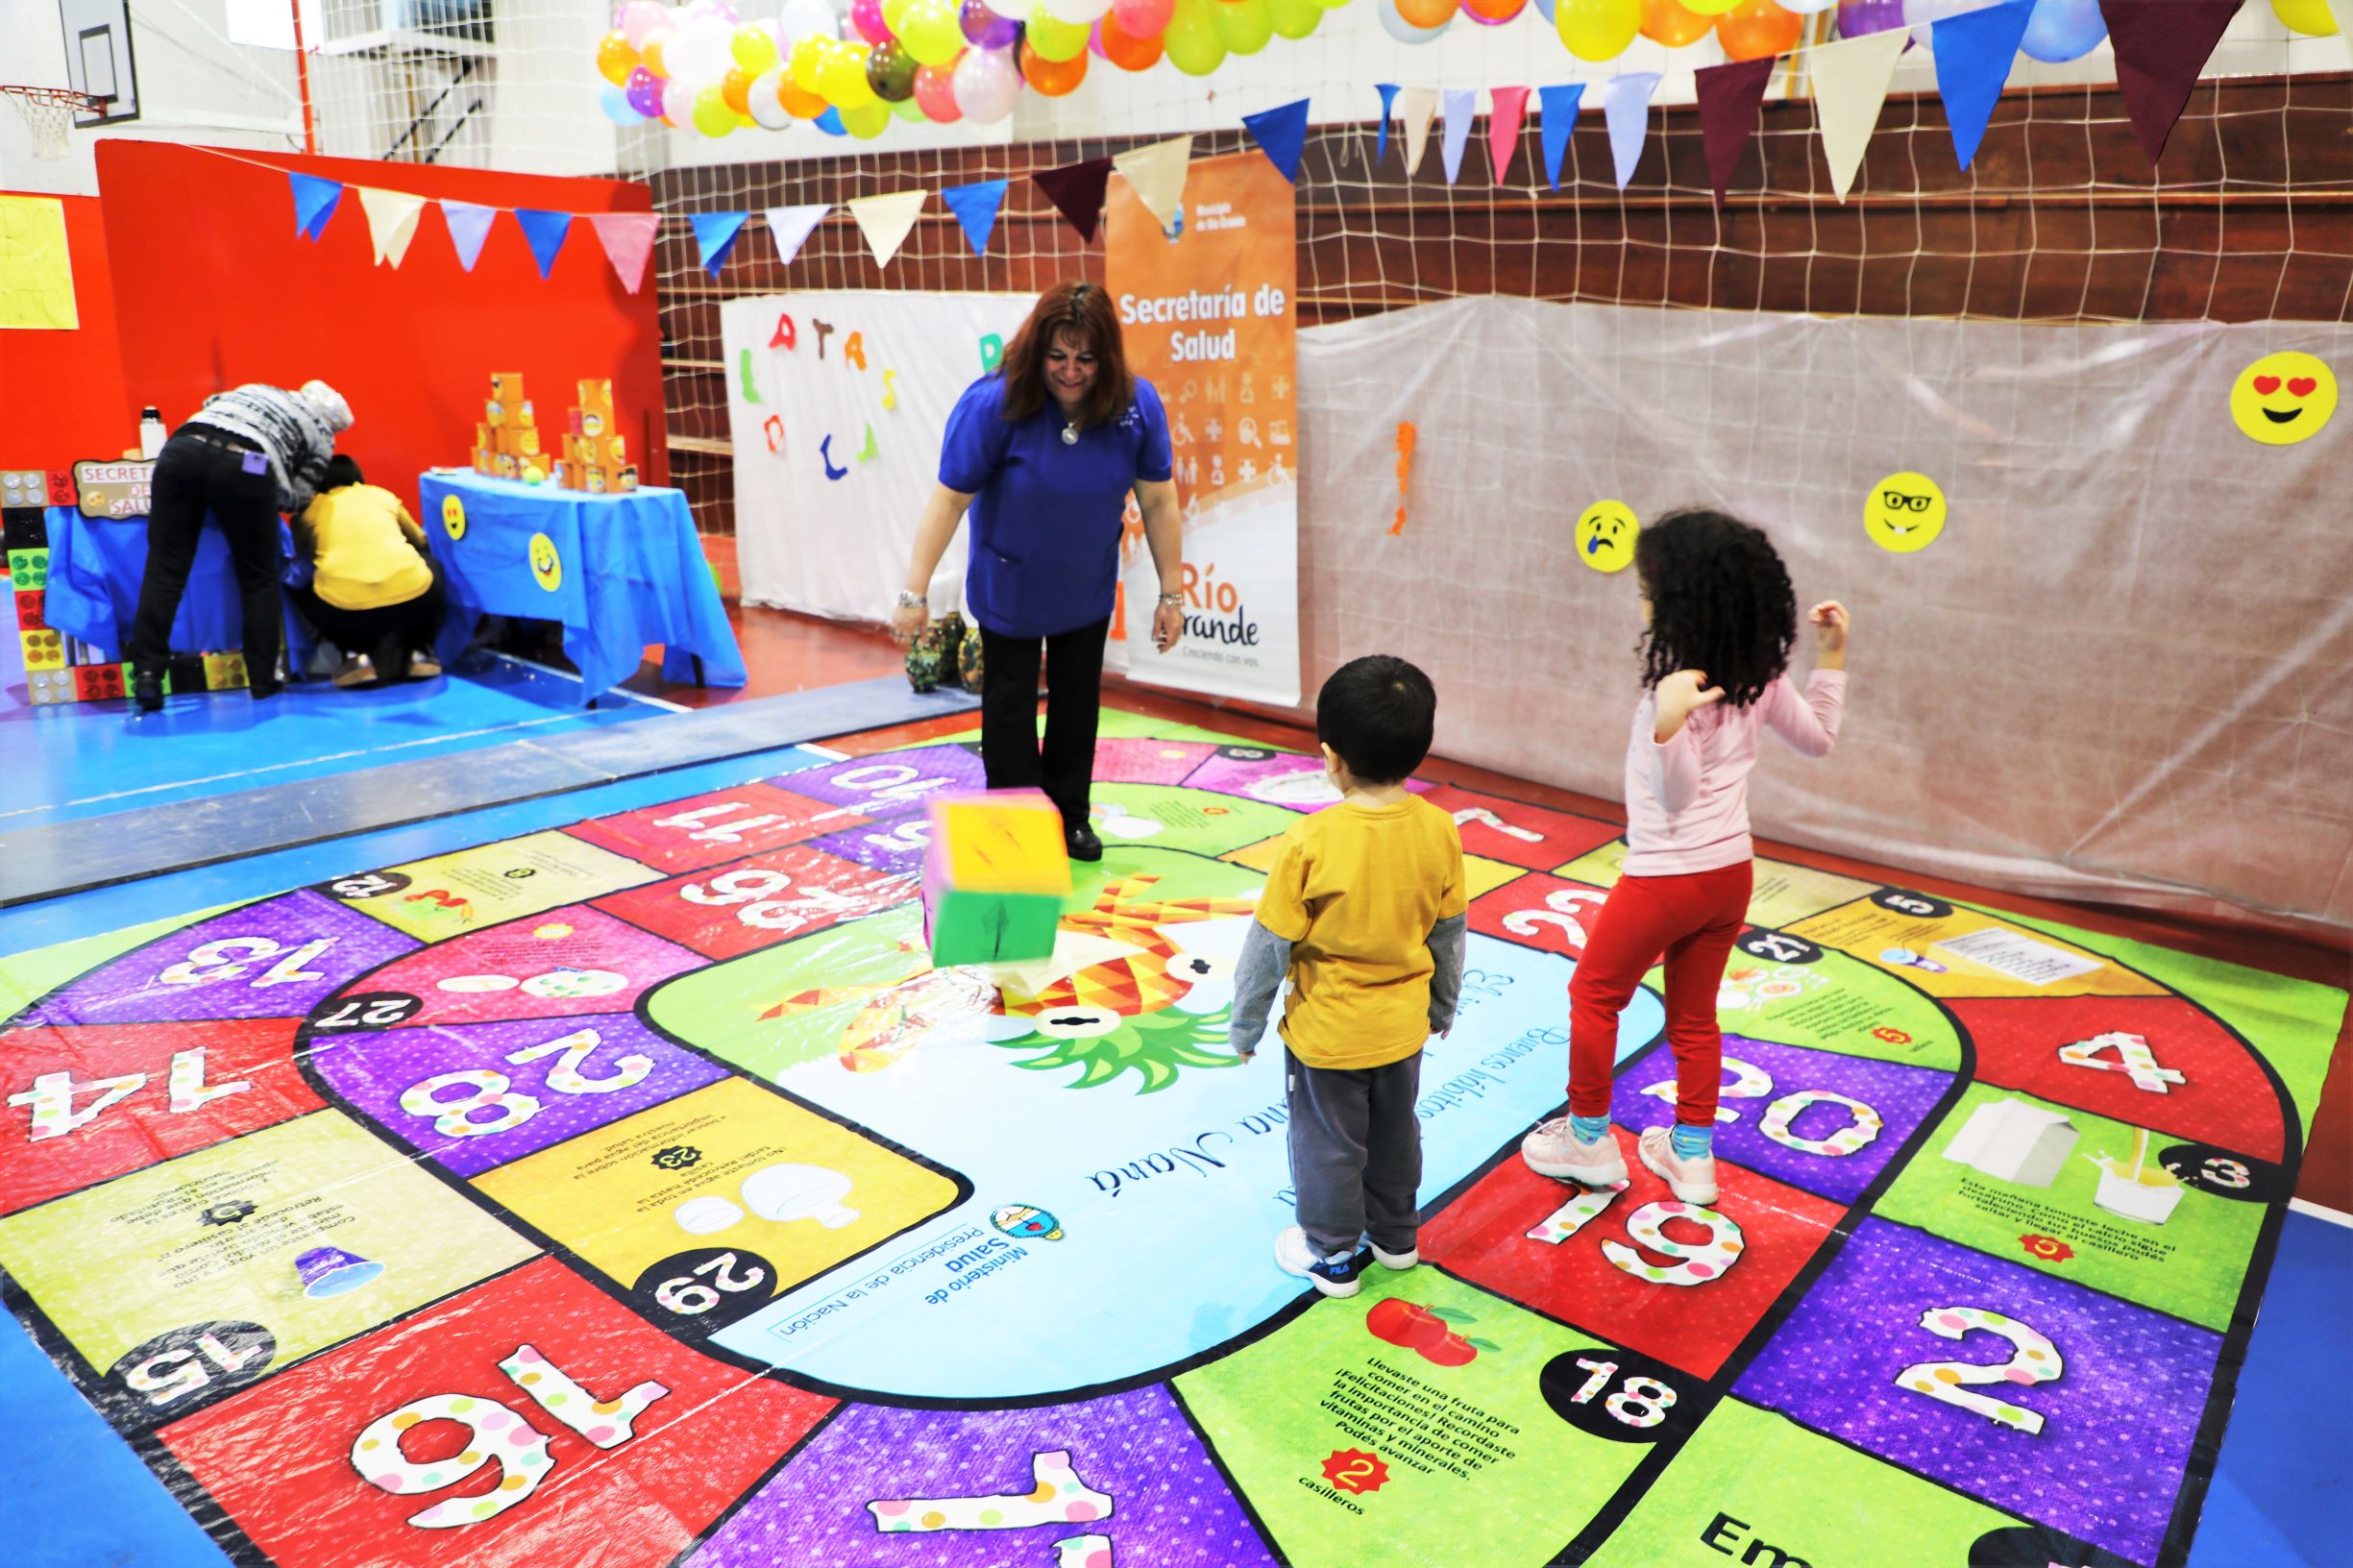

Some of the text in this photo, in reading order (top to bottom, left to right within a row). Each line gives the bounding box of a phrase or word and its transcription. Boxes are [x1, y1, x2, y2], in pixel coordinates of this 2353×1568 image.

[1119, 282, 1285, 325] Secretaría de
[1170, 328, 1236, 361] Salud
[85, 467, 149, 480] SECRET
[110, 500, 151, 515] SALU
[1181, 562, 1238, 614] Río
[1183, 605, 1260, 646] rande
[1885, 894, 1934, 914] 5
[159, 936, 341, 988] 13
[1748, 934, 1810, 961] 21
[315, 999, 412, 1026] 27
[400, 1029, 655, 1137] 28
[2059, 1032, 2186, 1093] 4
[7, 1046, 252, 1141] 14
[1640, 1055, 1884, 1157] 20
[659, 1147, 697, 1167] 23
[2200, 1157, 2252, 1188] 3
[1525, 1178, 1747, 1286] 19
[1960, 1177, 2176, 1252] Esta mañana tomaste leche en el
[923, 1247, 1029, 1308] Ministerio de
[943, 1236, 1010, 1274] Salud
[1329, 1264, 1350, 1275] FILA
[2034, 1239, 2059, 1256] 5
[655, 1253, 765, 1317] 29
[779, 1227, 984, 1336] Presidencia de la Nación
[126, 1333, 263, 1407] 15
[1367, 1357, 1520, 1436] Llevaste una fruta para
[1573, 1356, 1678, 1429] 18
[1895, 1306, 2065, 1435] 2
[1329, 1388, 1484, 1471] frutas por el aporte de
[1334, 1378, 1499, 1465] la importancia de comer
[1335, 1366, 1514, 1458] ¡Felicitaciones! Recordaste
[1367, 1369, 1501, 1438] comer en el camino
[350, 1344, 671, 1530] 16
[1319, 1398, 1473, 1480] vitaminas y minerales.
[1335, 1419, 1434, 1475] Podés avanzar
[1298, 1476, 1365, 1514] casilleros
[1336, 1458, 1375, 1488] 2
[867, 1449, 1114, 1568] 1
